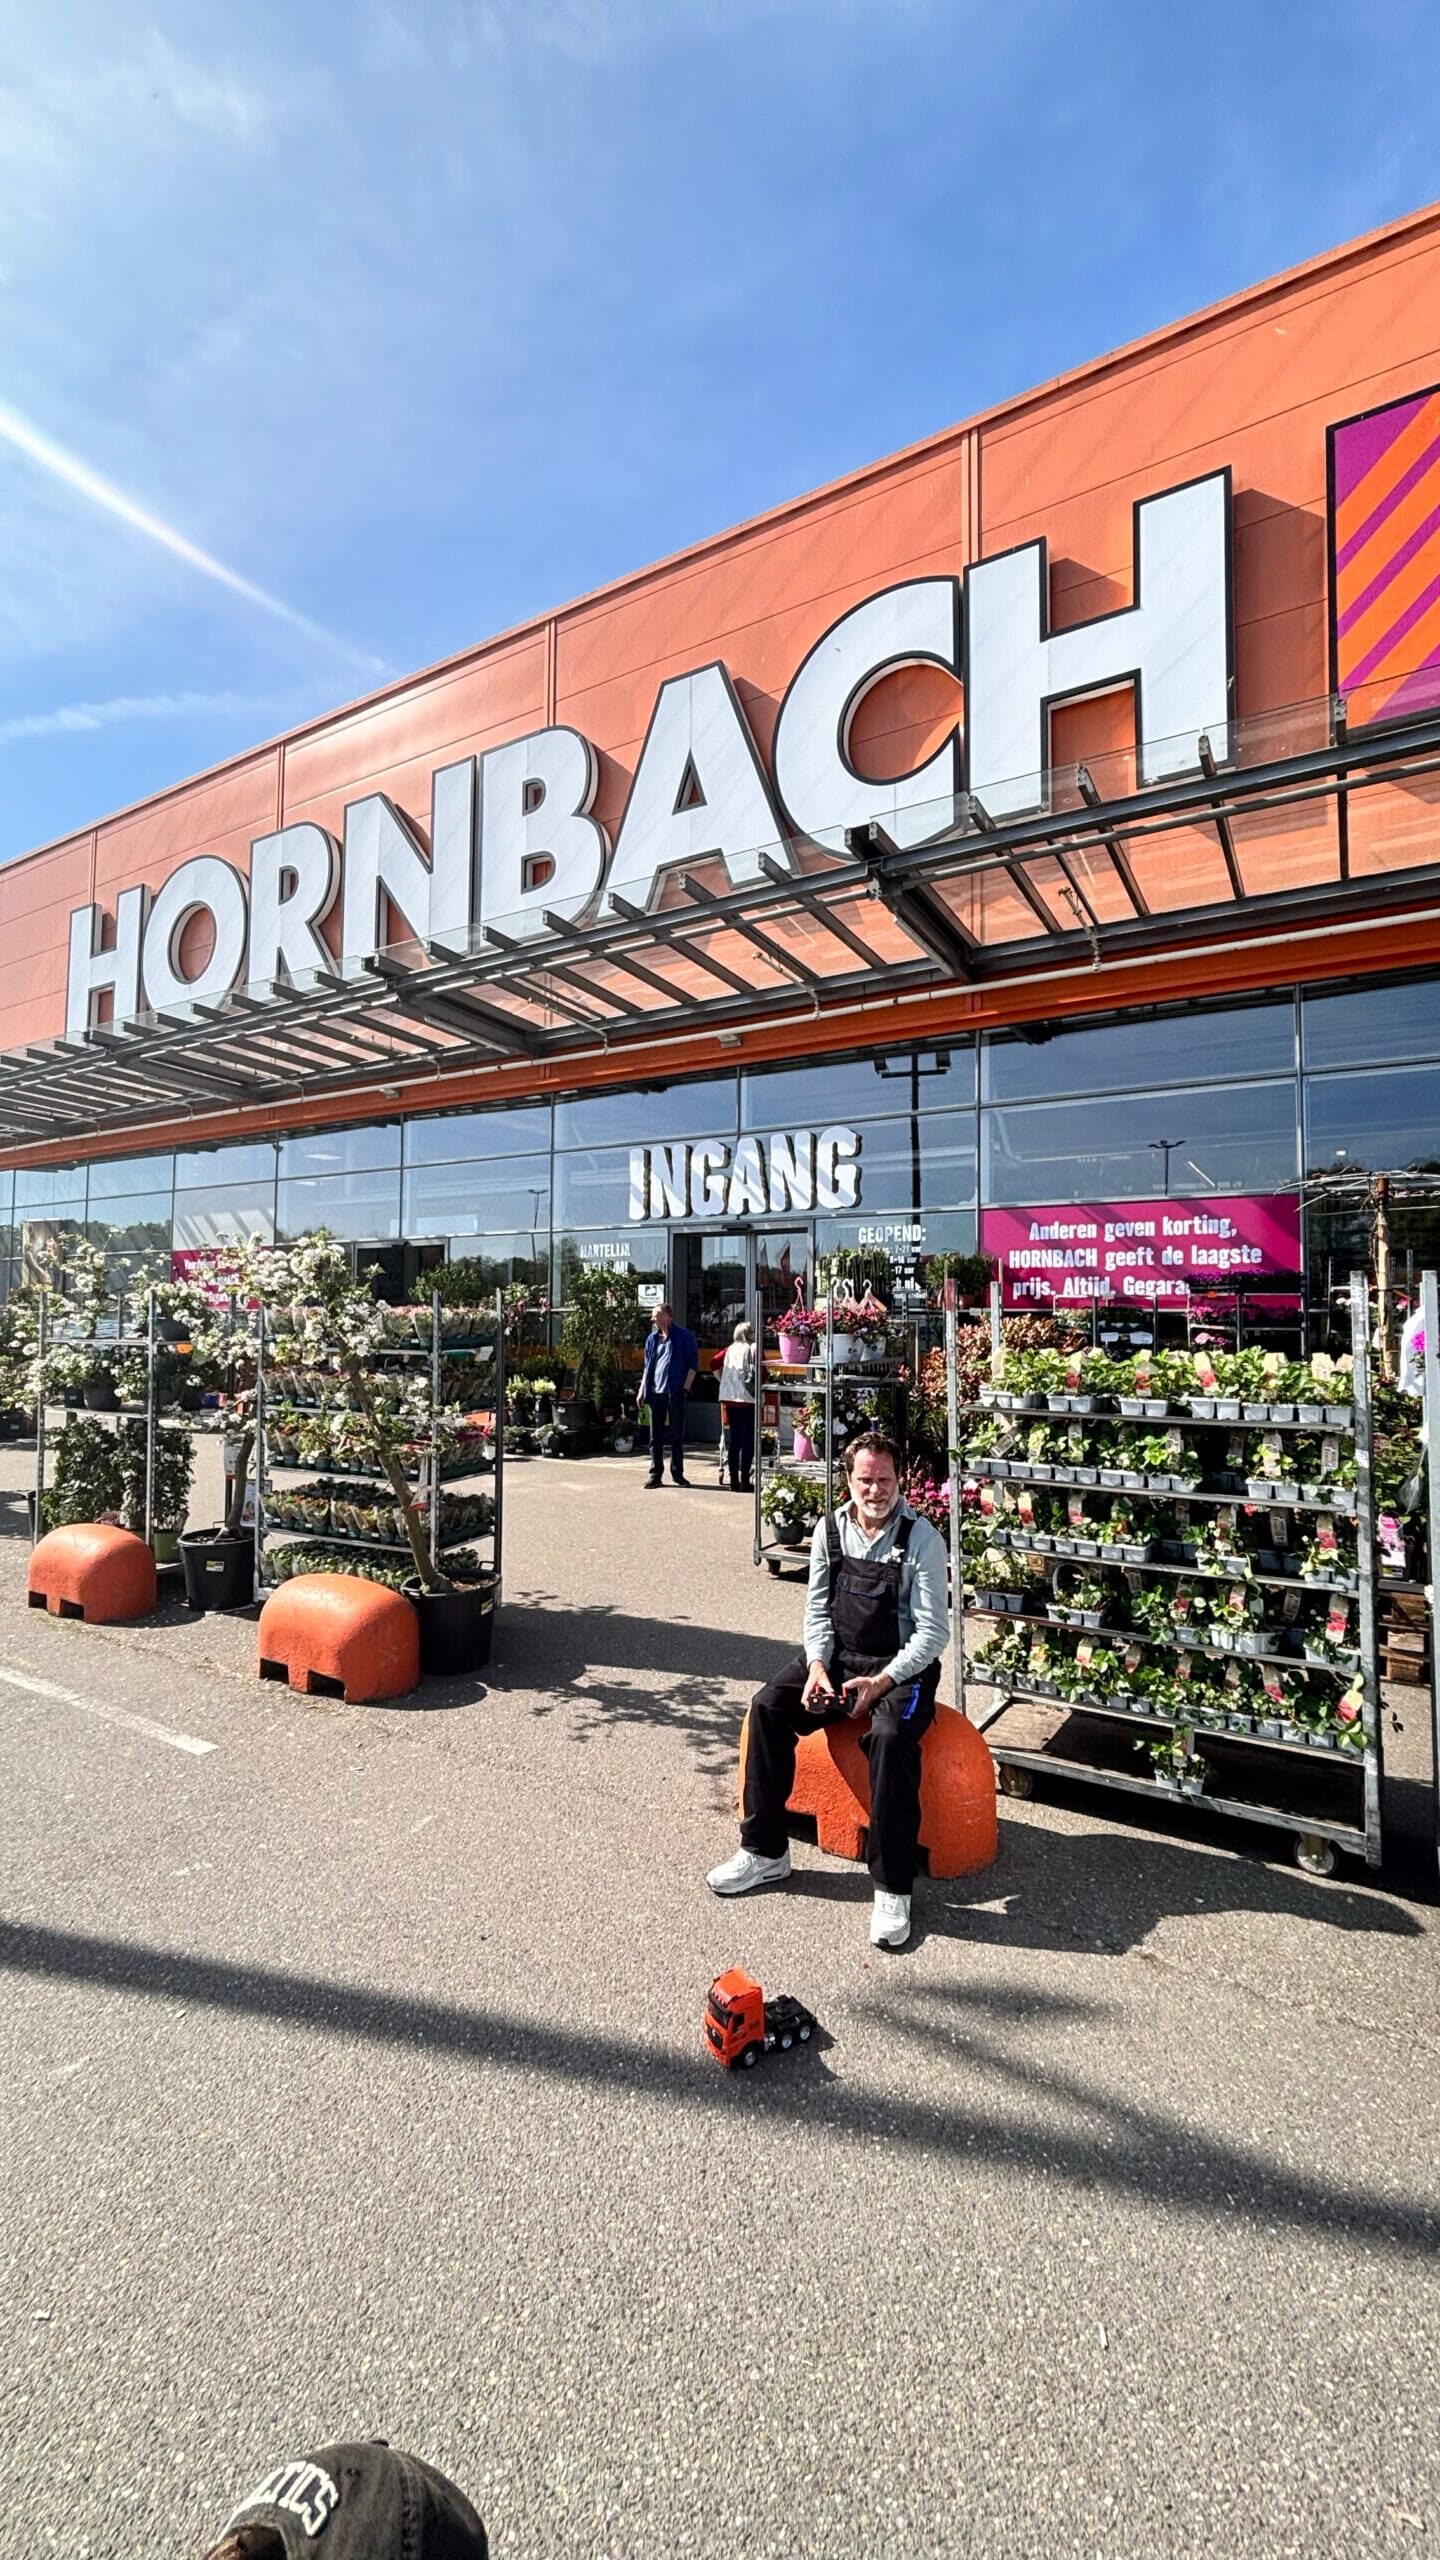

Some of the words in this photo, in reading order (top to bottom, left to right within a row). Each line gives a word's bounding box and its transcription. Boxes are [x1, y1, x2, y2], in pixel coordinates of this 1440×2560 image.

[65, 464, 1235, 1038] HORNBACH
[628, 1126, 862, 1221] INGANG
[858, 1224, 927, 1244] GEOPEND:
[1029, 1221, 1097, 1241] Anderen
[1104, 1219, 1156, 1243] geven
[1162, 1214, 1238, 1240] korting,
[1009, 1248, 1098, 1270] HORNBACH
[1105, 1246, 1154, 1272] geeft
[1161, 1245, 1185, 1266] de
[1191, 1244, 1263, 1270] laagste
[1013, 1277, 1056, 1299] prijs.
